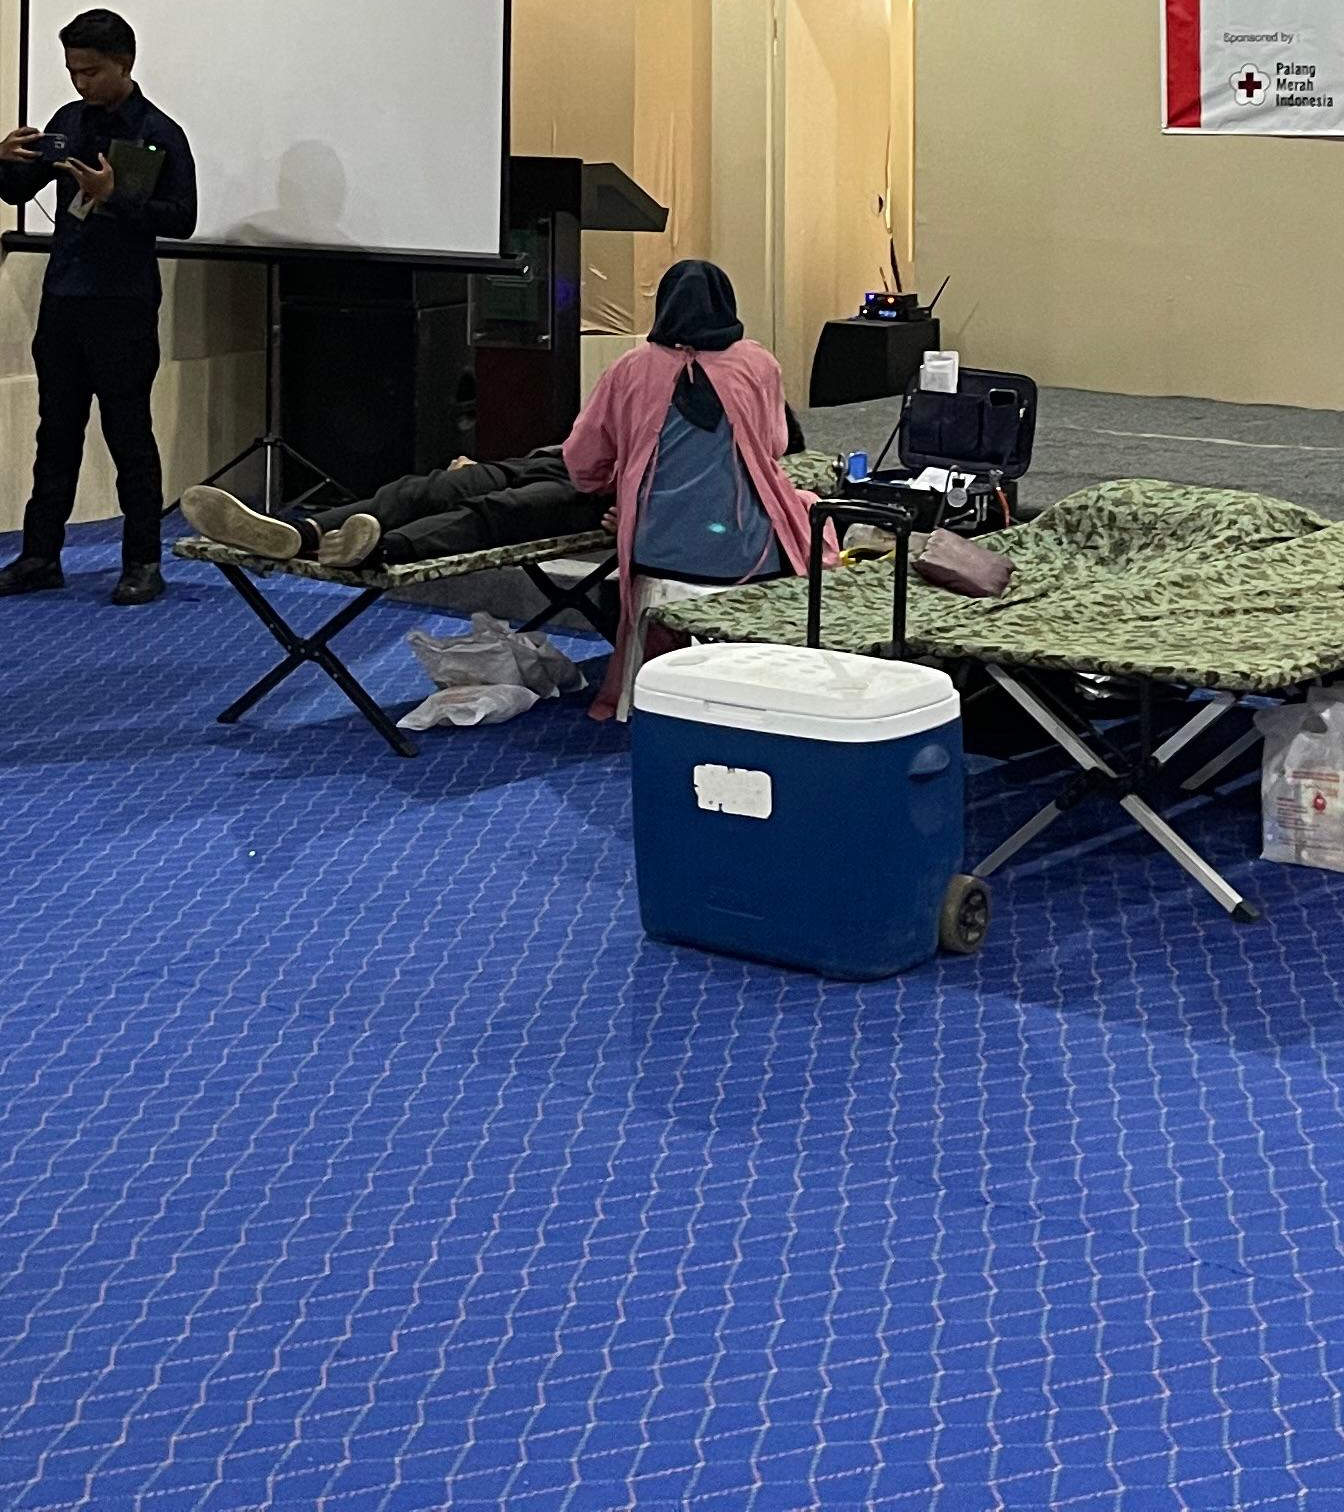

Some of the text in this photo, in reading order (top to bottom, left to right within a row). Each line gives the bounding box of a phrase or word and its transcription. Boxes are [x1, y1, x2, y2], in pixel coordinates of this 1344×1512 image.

[1223, 33, 1279, 45] Sponsored
[1275, 62, 1316, 78] Palang
[1275, 78, 1314, 92] Merah
[1275, 93, 1334, 107] Indonesia
